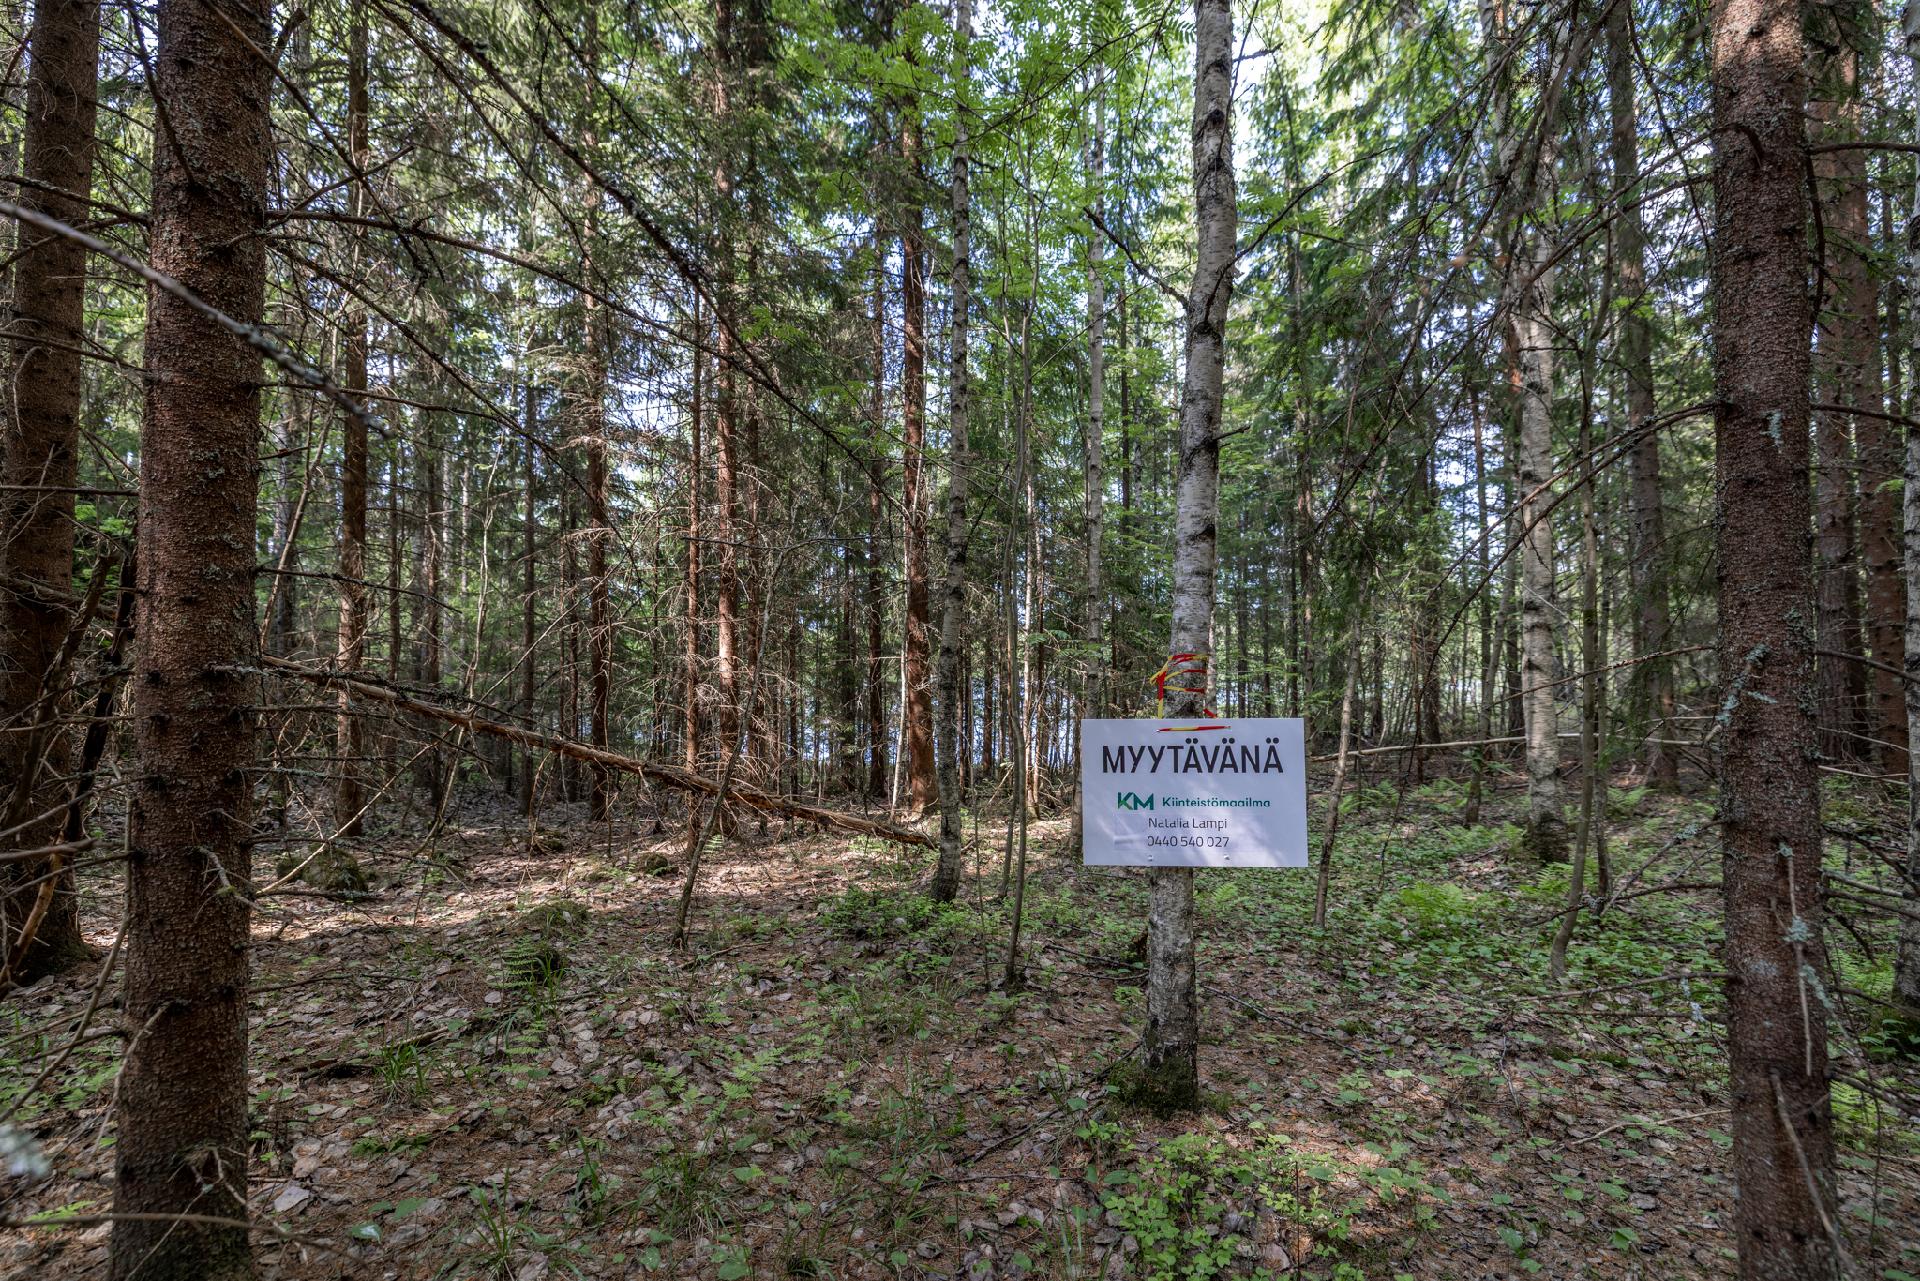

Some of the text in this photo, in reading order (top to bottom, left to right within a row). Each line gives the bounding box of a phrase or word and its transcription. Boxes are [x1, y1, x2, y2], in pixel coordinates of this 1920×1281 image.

[1102, 737, 1284, 774] MYYTÄVÄNÄ
[1117, 791, 1271, 811] KM Kiinteistömaailma
[1148, 817, 1228, 831] Natalia Lampi
[1147, 835, 1230, 848] 0440 540 027
